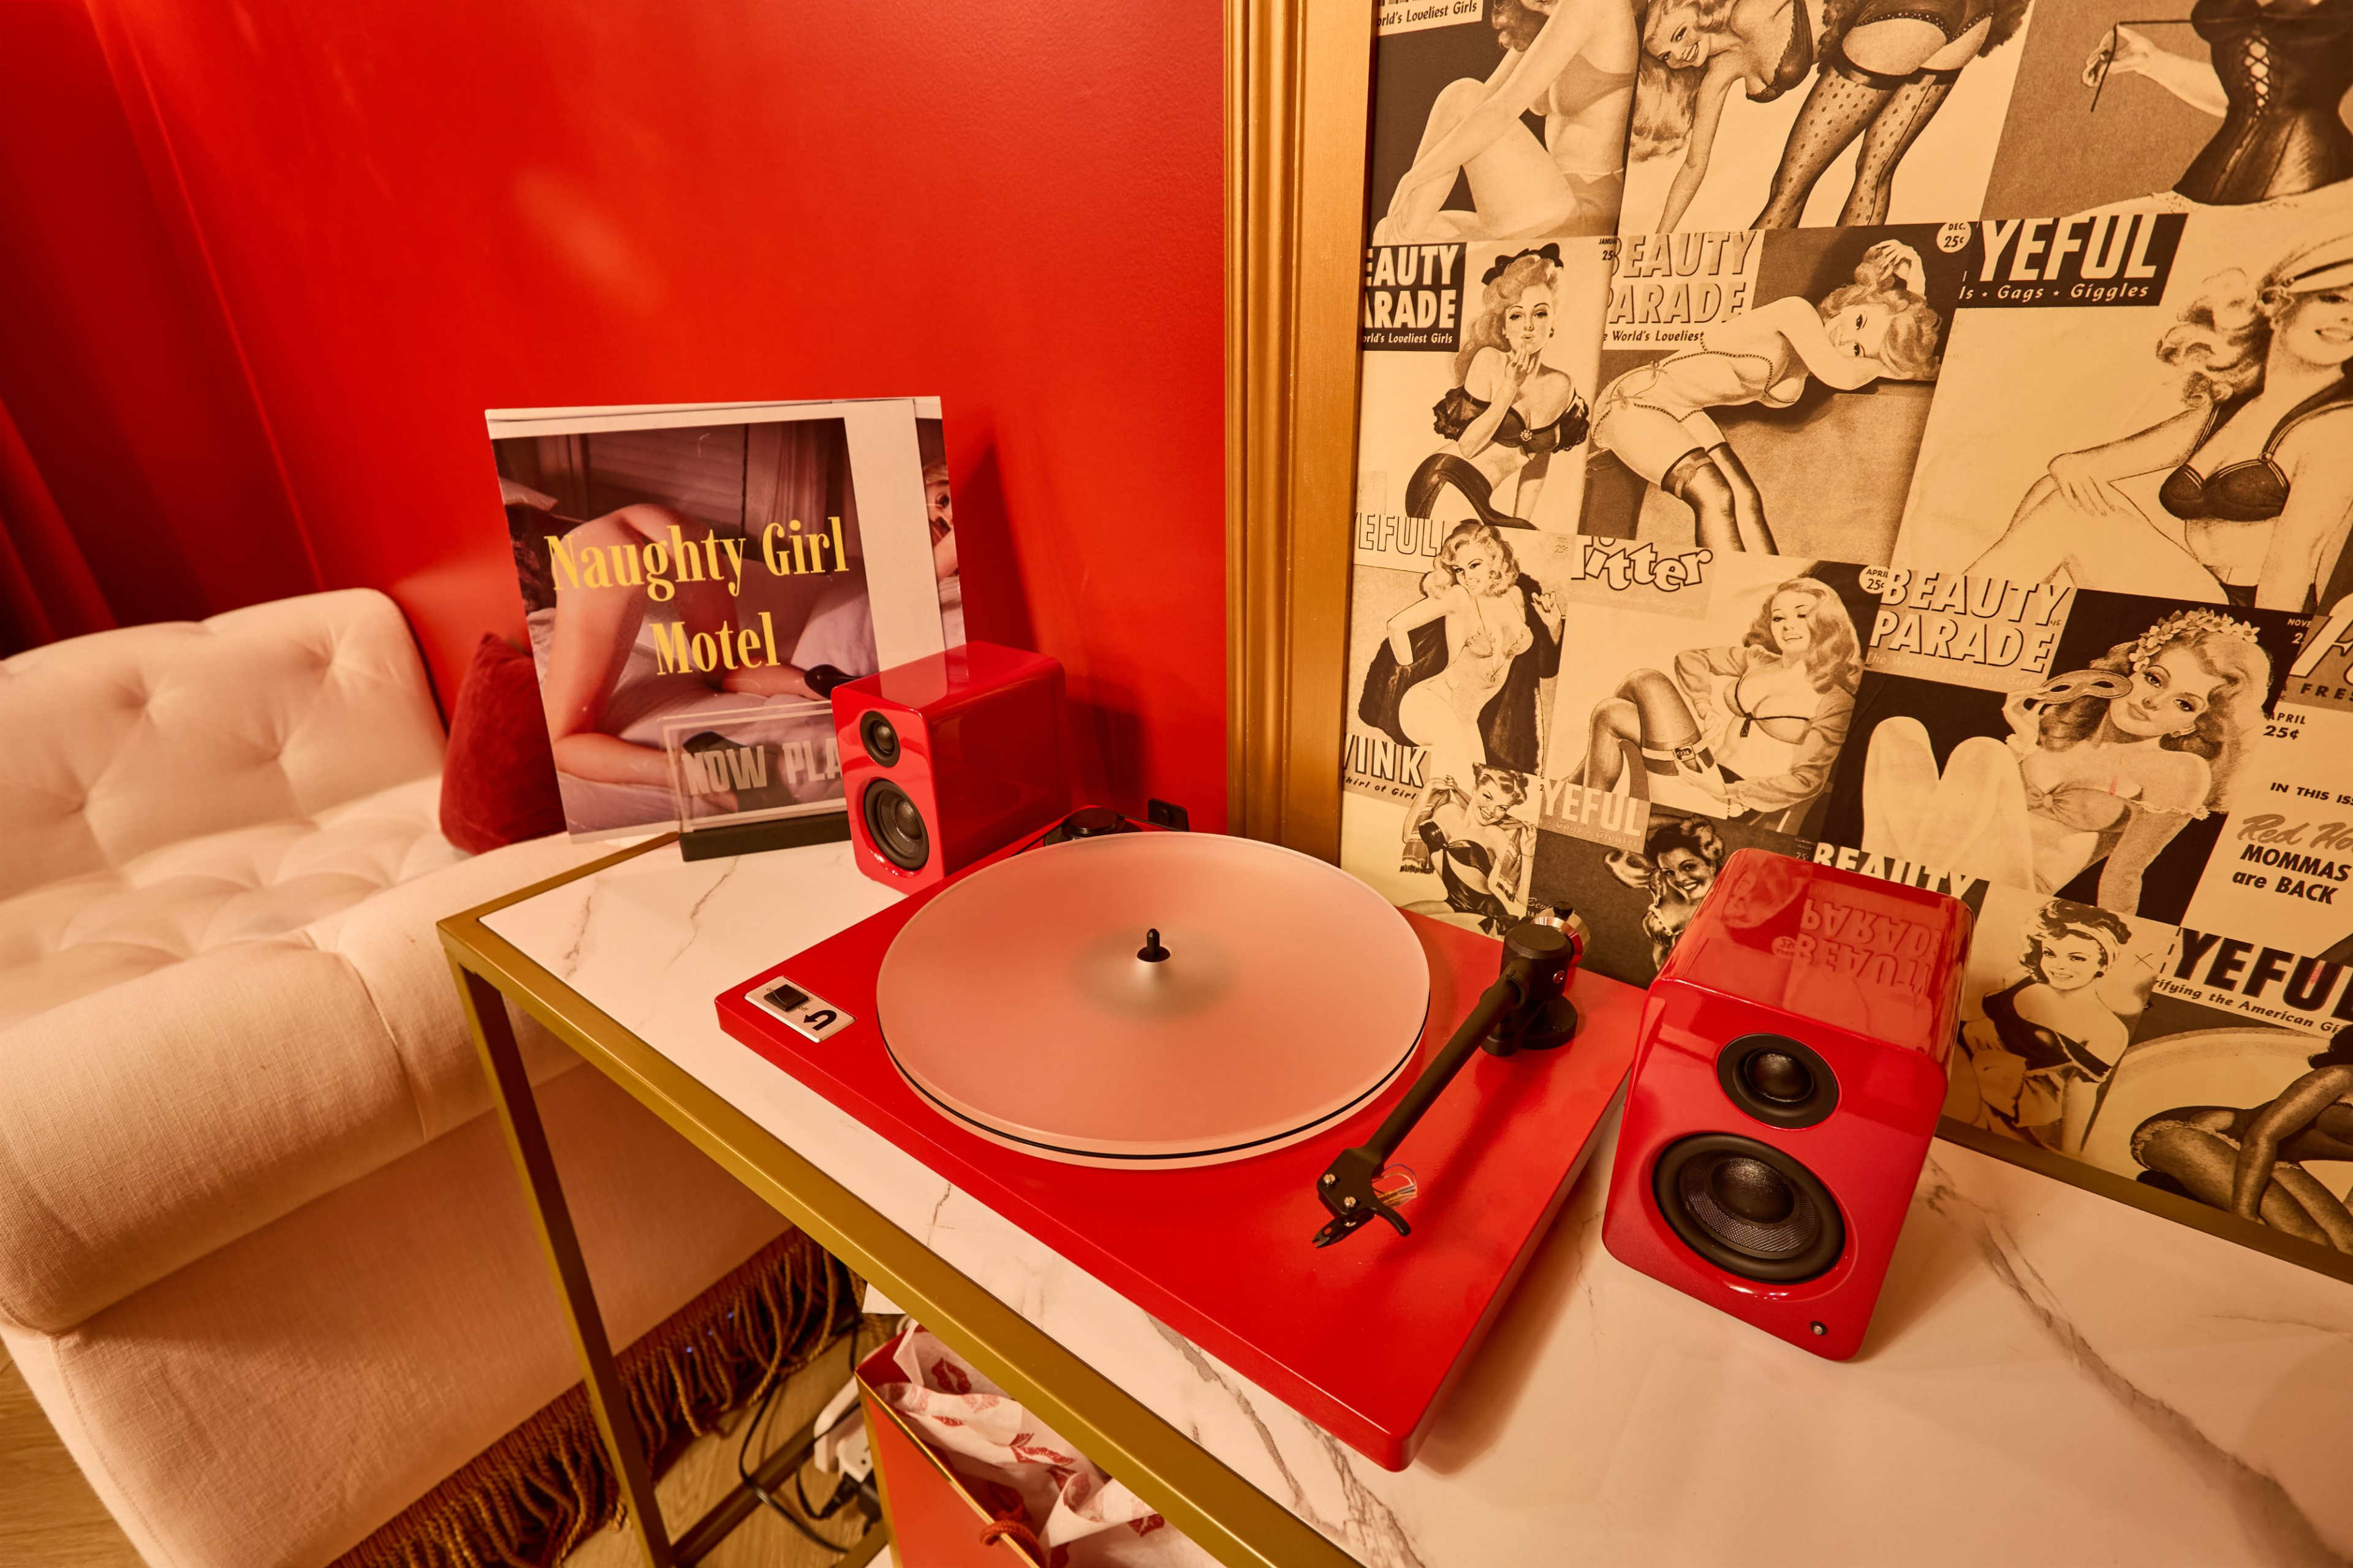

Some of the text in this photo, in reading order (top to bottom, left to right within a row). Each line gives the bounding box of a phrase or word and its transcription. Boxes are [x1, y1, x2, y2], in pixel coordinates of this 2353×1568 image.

[1406, 5, 1449, 23] Loveliest
[1452, 1, 1477, 15] Girls
[1947, 222, 1966, 231] DEC.
[1979, 214, 2158, 282] YEFUL
[1607, 282, 1746, 324] ARADE
[1997, 284, 2044, 303] Gags
[2069, 282, 2149, 303] Giggles
[1389, 332, 1427, 344] Loveliest
[1431, 332, 1453, 344] Girls
[1612, 330, 1650, 342] World's
[1655, 330, 1704, 343] Loveliest
[544, 517, 850, 602] Naughty Girl
[1879, 569, 2071, 627] BEAUTY
[648, 612, 781, 676] Motel
[1869, 610, 2055, 673] PARADE
[2263, 725, 2300, 740] 25¢
[2269, 712, 2306, 725] APRIL
[681, 737, 843, 795] NOW PLA
[1344, 734, 1427, 789] INK
[1544, 778, 1641, 837] YEFUL
[2270, 782, 2290, 793] IN
[2297, 787, 2330, 801] THIS
[2237, 813, 2353, 853] Red Ho
[2240, 844, 2352, 882] MOMMAS
[2232, 871, 2339, 905] are BACK
[2208, 993, 2234, 1006] the
[2238, 1001, 2314, 1028] American
